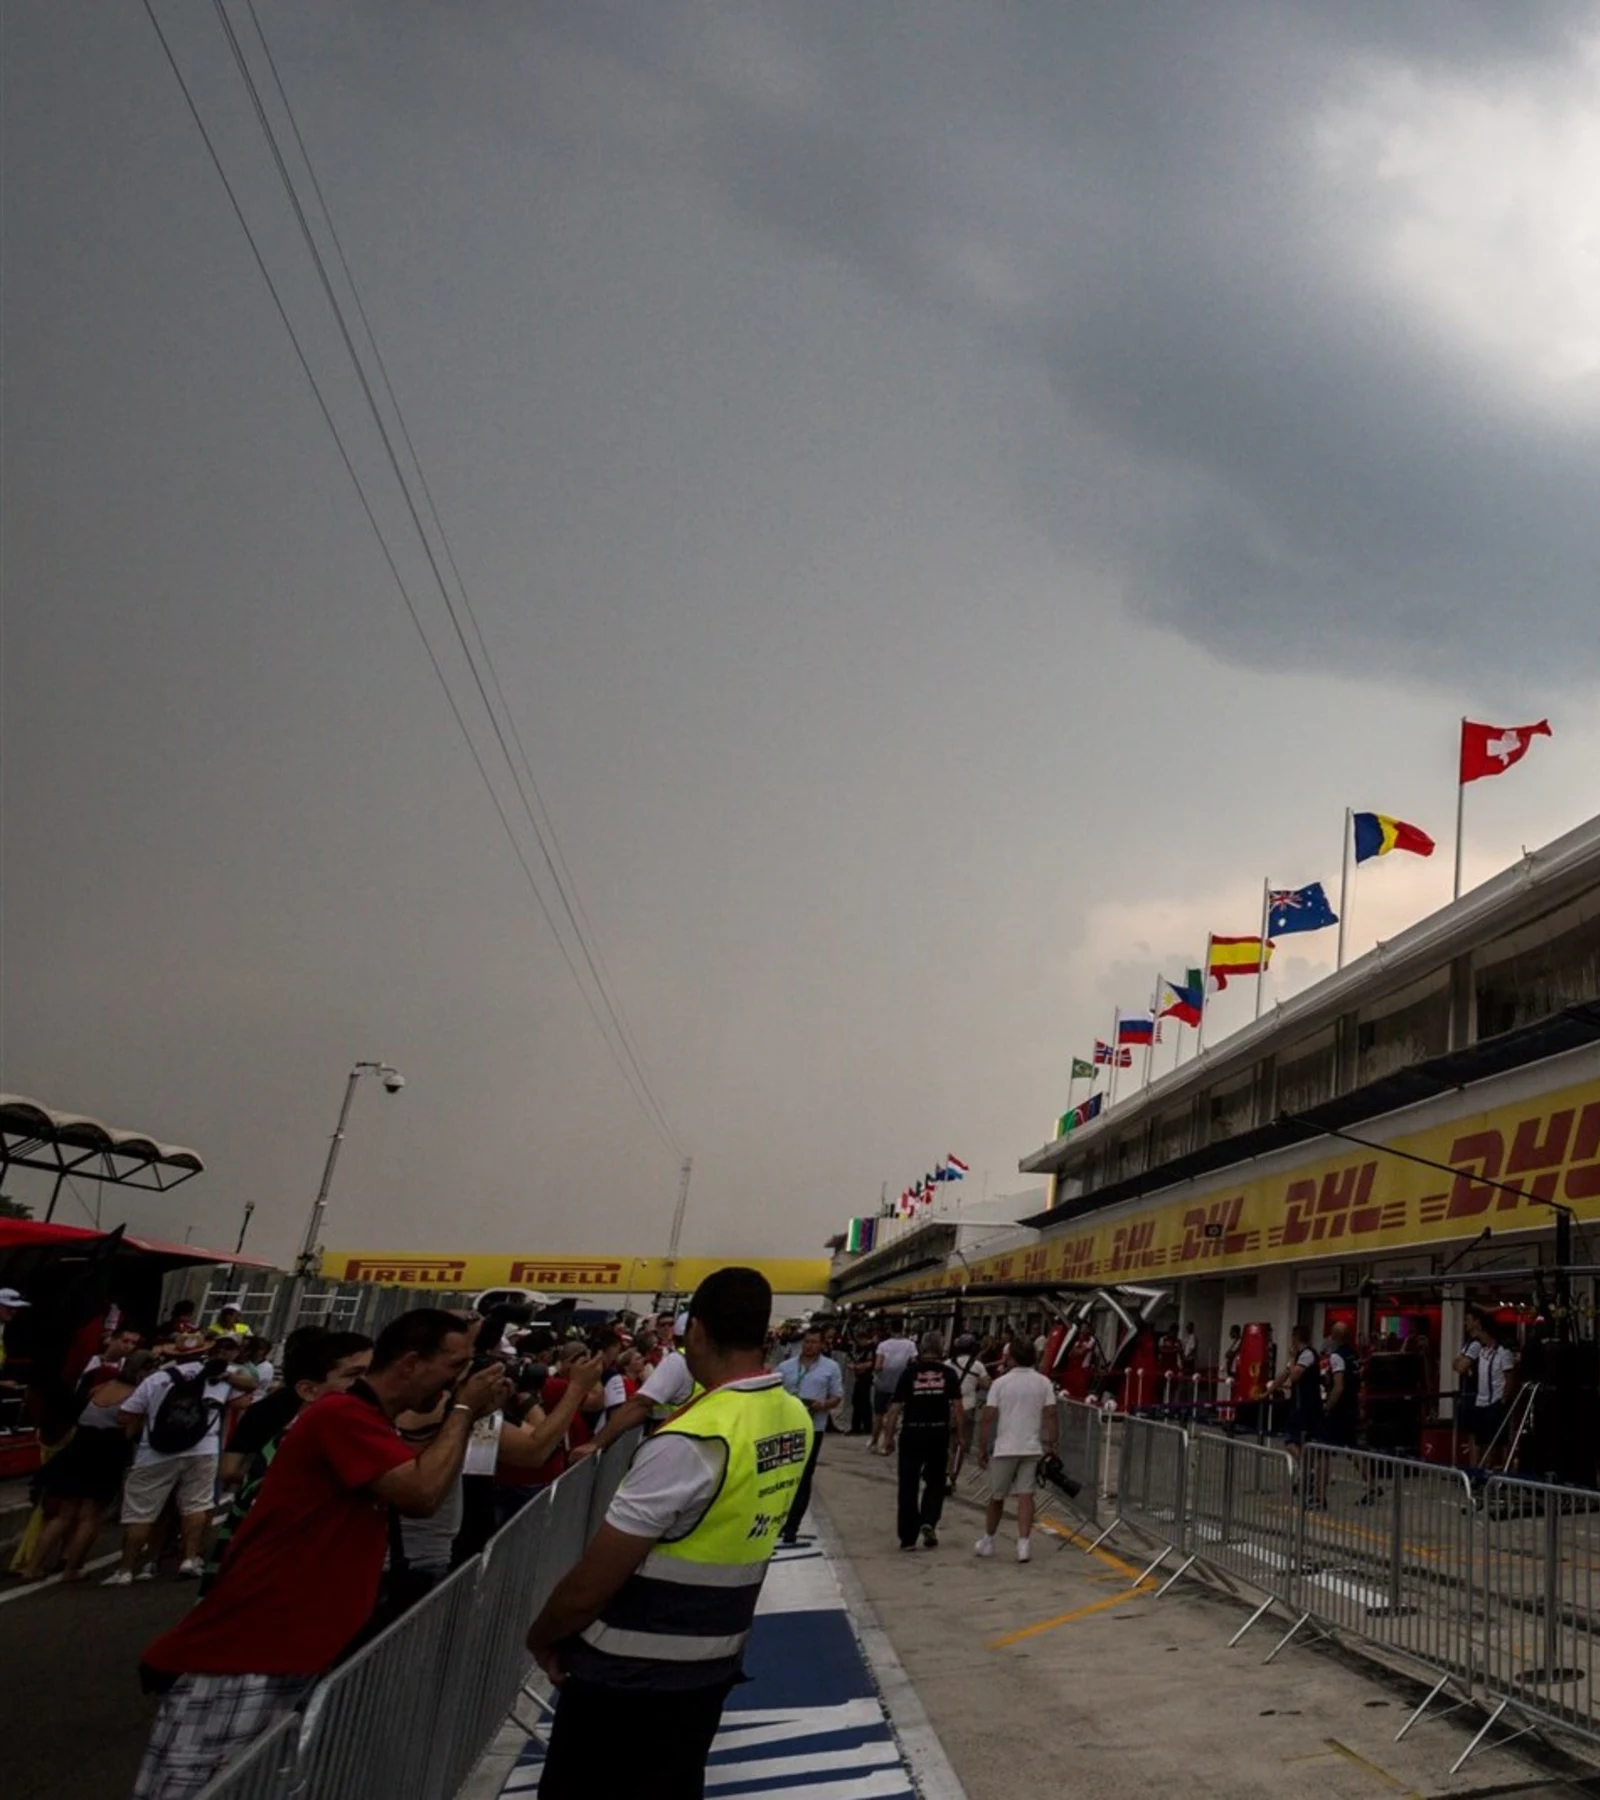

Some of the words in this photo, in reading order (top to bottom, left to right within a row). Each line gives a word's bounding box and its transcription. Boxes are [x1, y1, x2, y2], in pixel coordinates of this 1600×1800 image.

[1282, 1161, 1383, 1245] DHL
[1111, 1220, 1156, 1271] DHL
[1181, 1197, 1247, 1261] DHL
[345, 1259, 466, 1282] PIRELLI
[509, 1261, 622, 1284] PIRELLI
